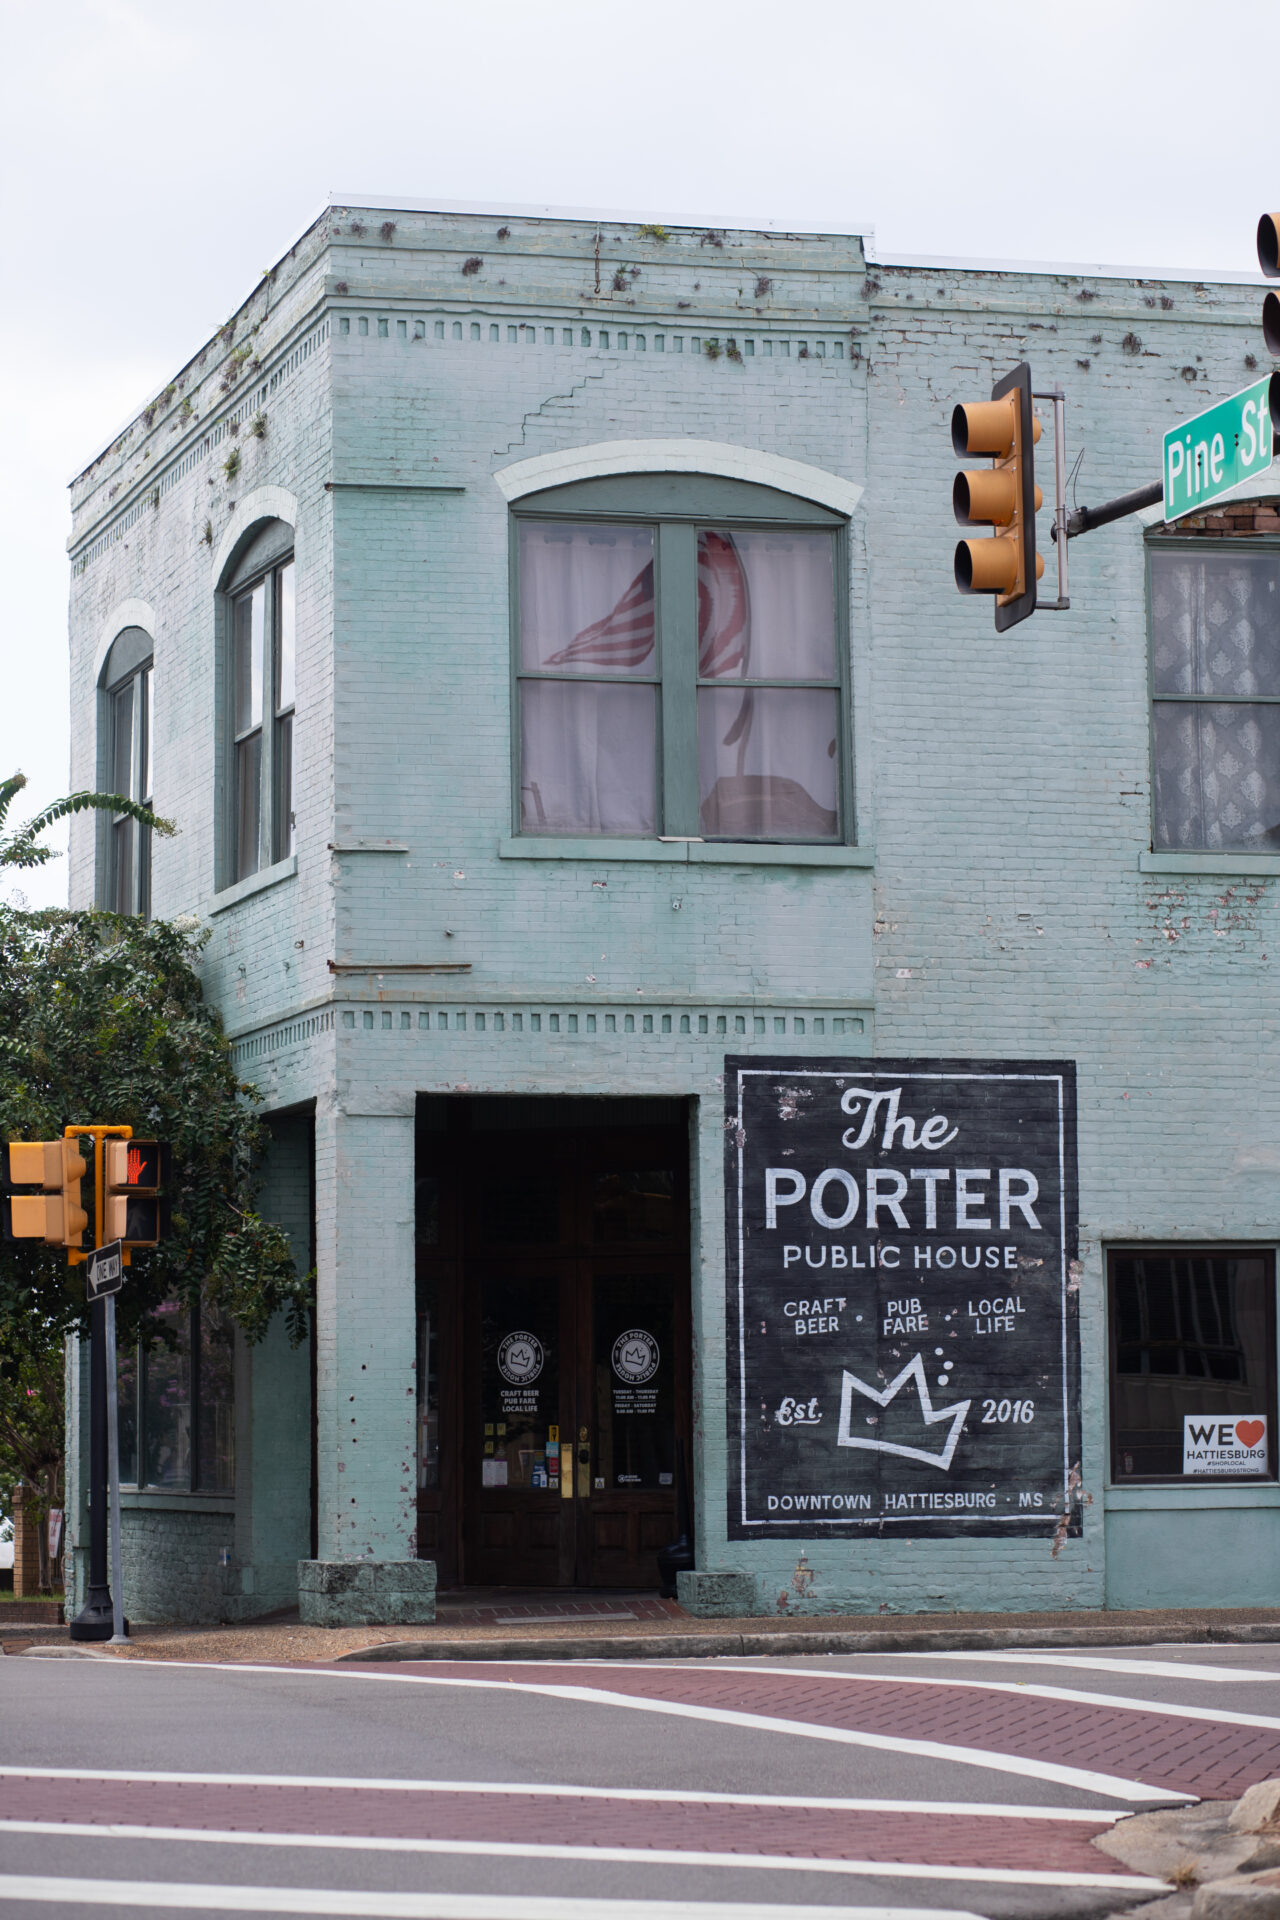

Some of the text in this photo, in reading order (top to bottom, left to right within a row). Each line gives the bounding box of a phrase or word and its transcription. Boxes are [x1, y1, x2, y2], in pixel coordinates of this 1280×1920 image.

[1168, 393, 1268, 507] Pine St
[841, 1087, 958, 1150] The
[765, 1168, 1042, 1230] PORTER
[783, 1245, 1018, 1269] PUBLIC HOUSE
[97, 1261, 109, 1283] ONE
[783, 1298, 846, 1317] CRAFT
[887, 1298, 922, 1316] PUB
[968, 1296, 1026, 1316] LOCAL
[795, 1317, 840, 1335] BEER
[883, 1314, 929, 1335] FARE
[976, 1315, 1016, 1335] LIFE
[502, 1334, 538, 1350] THE PORTER
[617, 1332, 654, 1348] THE PORTER
[521, 1363, 541, 1382] PUBLIC
[615, 1362, 657, 1381] PUBLIC HOUSE
[777, 1397, 823, 1426] Est.
[981, 1399, 1034, 1424] 2016
[1188, 1424, 1234, 1446] WE
[1186, 1449, 1265, 1460] HATTIESBURG
[767, 1493, 1043, 1511] DOWNTOWN HATTIESBURG MS
